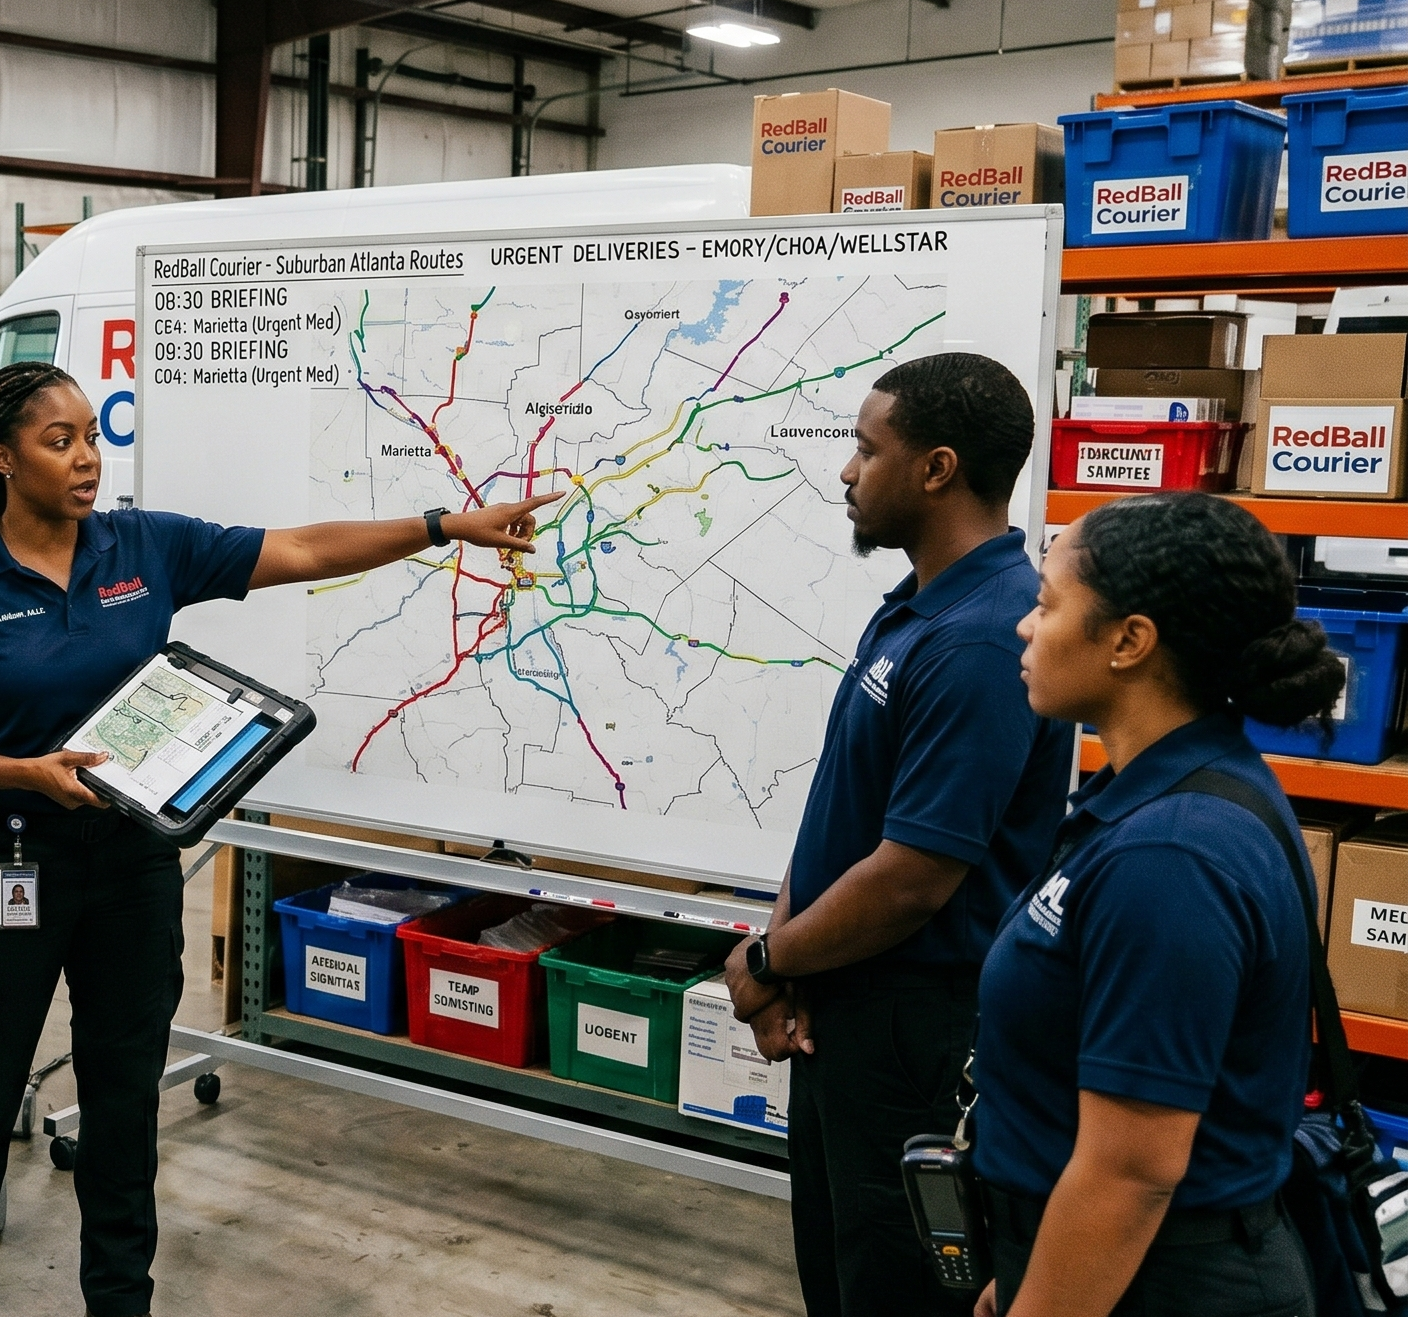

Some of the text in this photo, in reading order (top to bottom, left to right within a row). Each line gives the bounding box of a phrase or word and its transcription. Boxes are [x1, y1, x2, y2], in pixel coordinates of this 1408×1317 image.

[761, 117, 827, 138] RedBall
[761, 136, 826, 156] Courier
[940, 166, 1023, 187] RedBall
[843, 189, 903, 205] RedBall
[940, 187, 1021, 207] Courier
[1097, 183, 1182, 205] RedBall
[1096, 204, 1180, 225] Courier
[491, 245, 563, 266] URGENT
[573, 240, 680, 262] DELIVERIES
[702, 230, 948, 262] EMORY/CHOA/WELLSTAR
[154, 258, 206, 279] RedBall
[210, 256, 262, 277] Courier
[276, 253, 346, 275] Suburban
[350, 251, 405, 273] Atlanta
[409, 249, 464, 270] Routes
[154, 287, 288, 311] 08:30 BRIEFING
[193, 316, 248, 334] Marietta
[252, 313, 302, 337] (Urgent
[306, 305, 341, 336] Med)
[154, 340, 289, 361] 09:30 BRIEFING
[193, 367, 247, 384] Marietta
[251, 365, 302, 388] (Urgent
[306, 363, 339, 386] Med)
[1272, 426, 1386, 448] RedBall
[381, 444, 432, 458] Marietta
[1272, 451, 1383, 473] Courier
